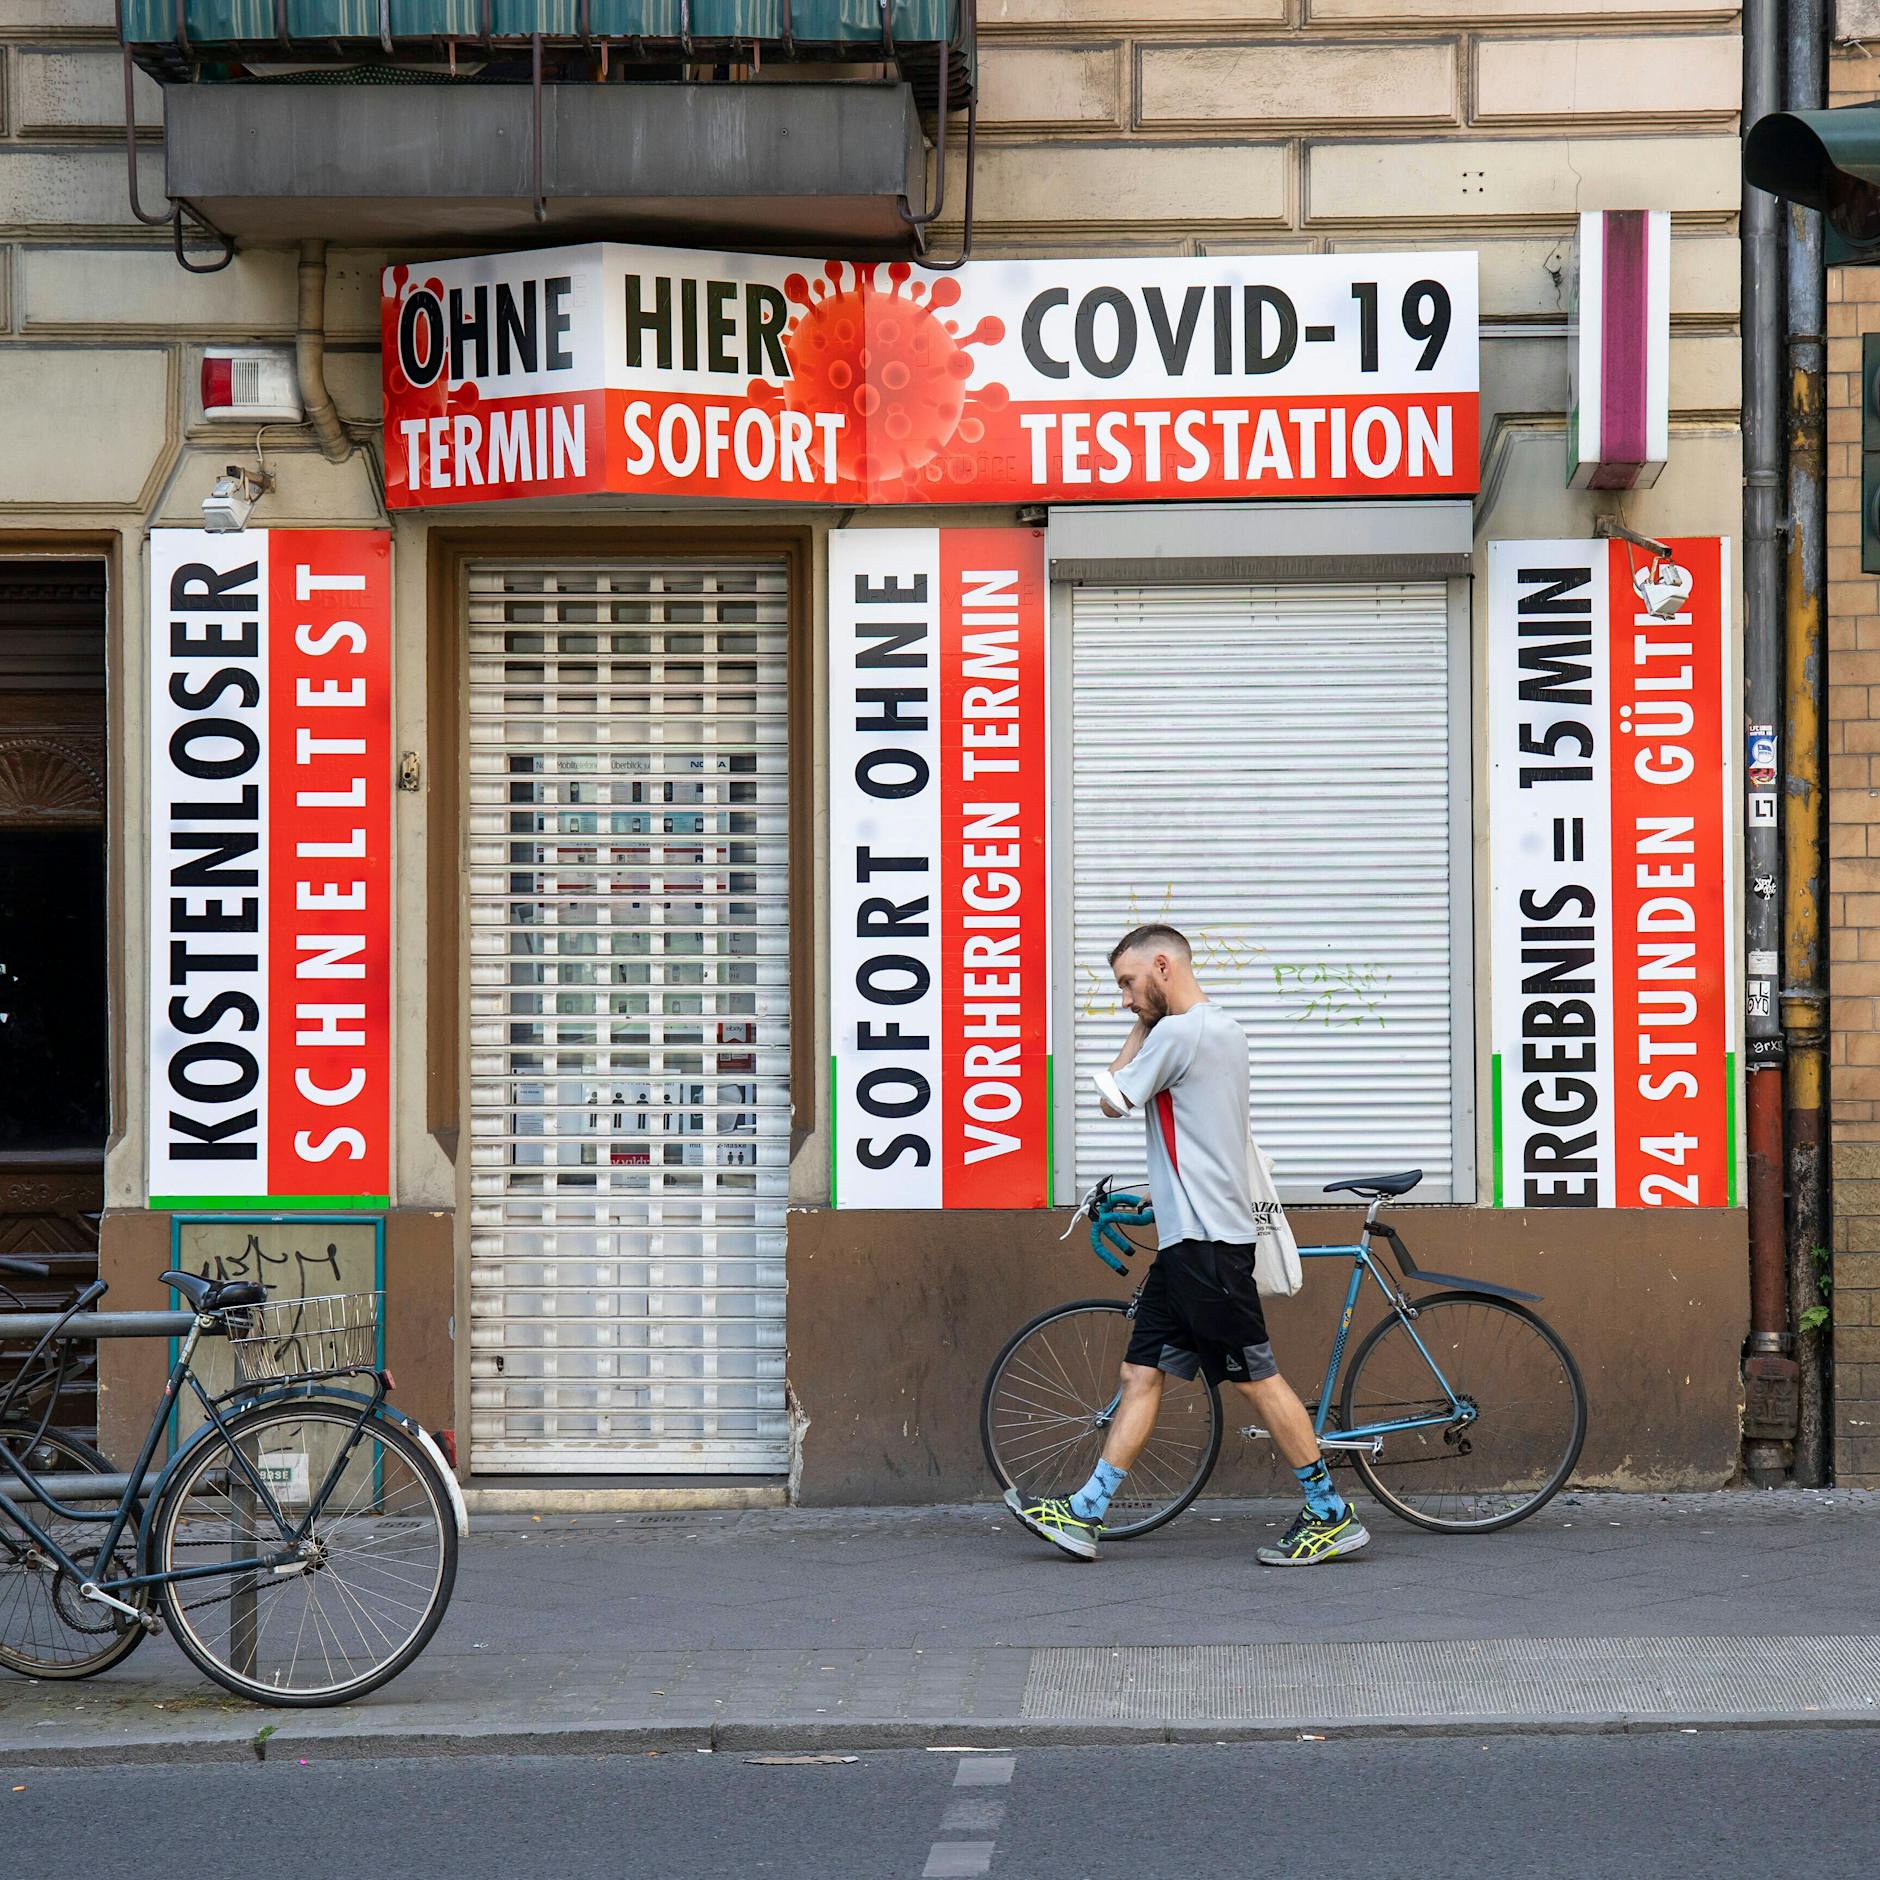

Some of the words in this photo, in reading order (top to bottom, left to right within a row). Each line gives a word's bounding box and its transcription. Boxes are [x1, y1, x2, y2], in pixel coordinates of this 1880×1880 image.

[400, 276, 573, 387] OHNE
[624, 274, 790, 377] HIER
[1021, 279, 1452, 379] COVID-19
[401, 404, 586, 490] TERMIN
[624, 401, 846, 484] SOFORT
[1020, 405, 1453, 485] TESTSTATION
[855, 573, 930, 800] OHNE
[962, 570, 1021, 781] TERMIN
[168, 560, 260, 1161] KOSTENLOSER
[295, 564, 367, 1162] SCHNELLTEST
[1637, 817, 1699, 1101] STUNDEN
[856, 845, 931, 1170] SOFORT
[963, 803, 1022, 1165] VORHERIGEN
[1519, 884, 1598, 1208] ERGEBNIS
[1640, 1132, 1699, 1206] 24
